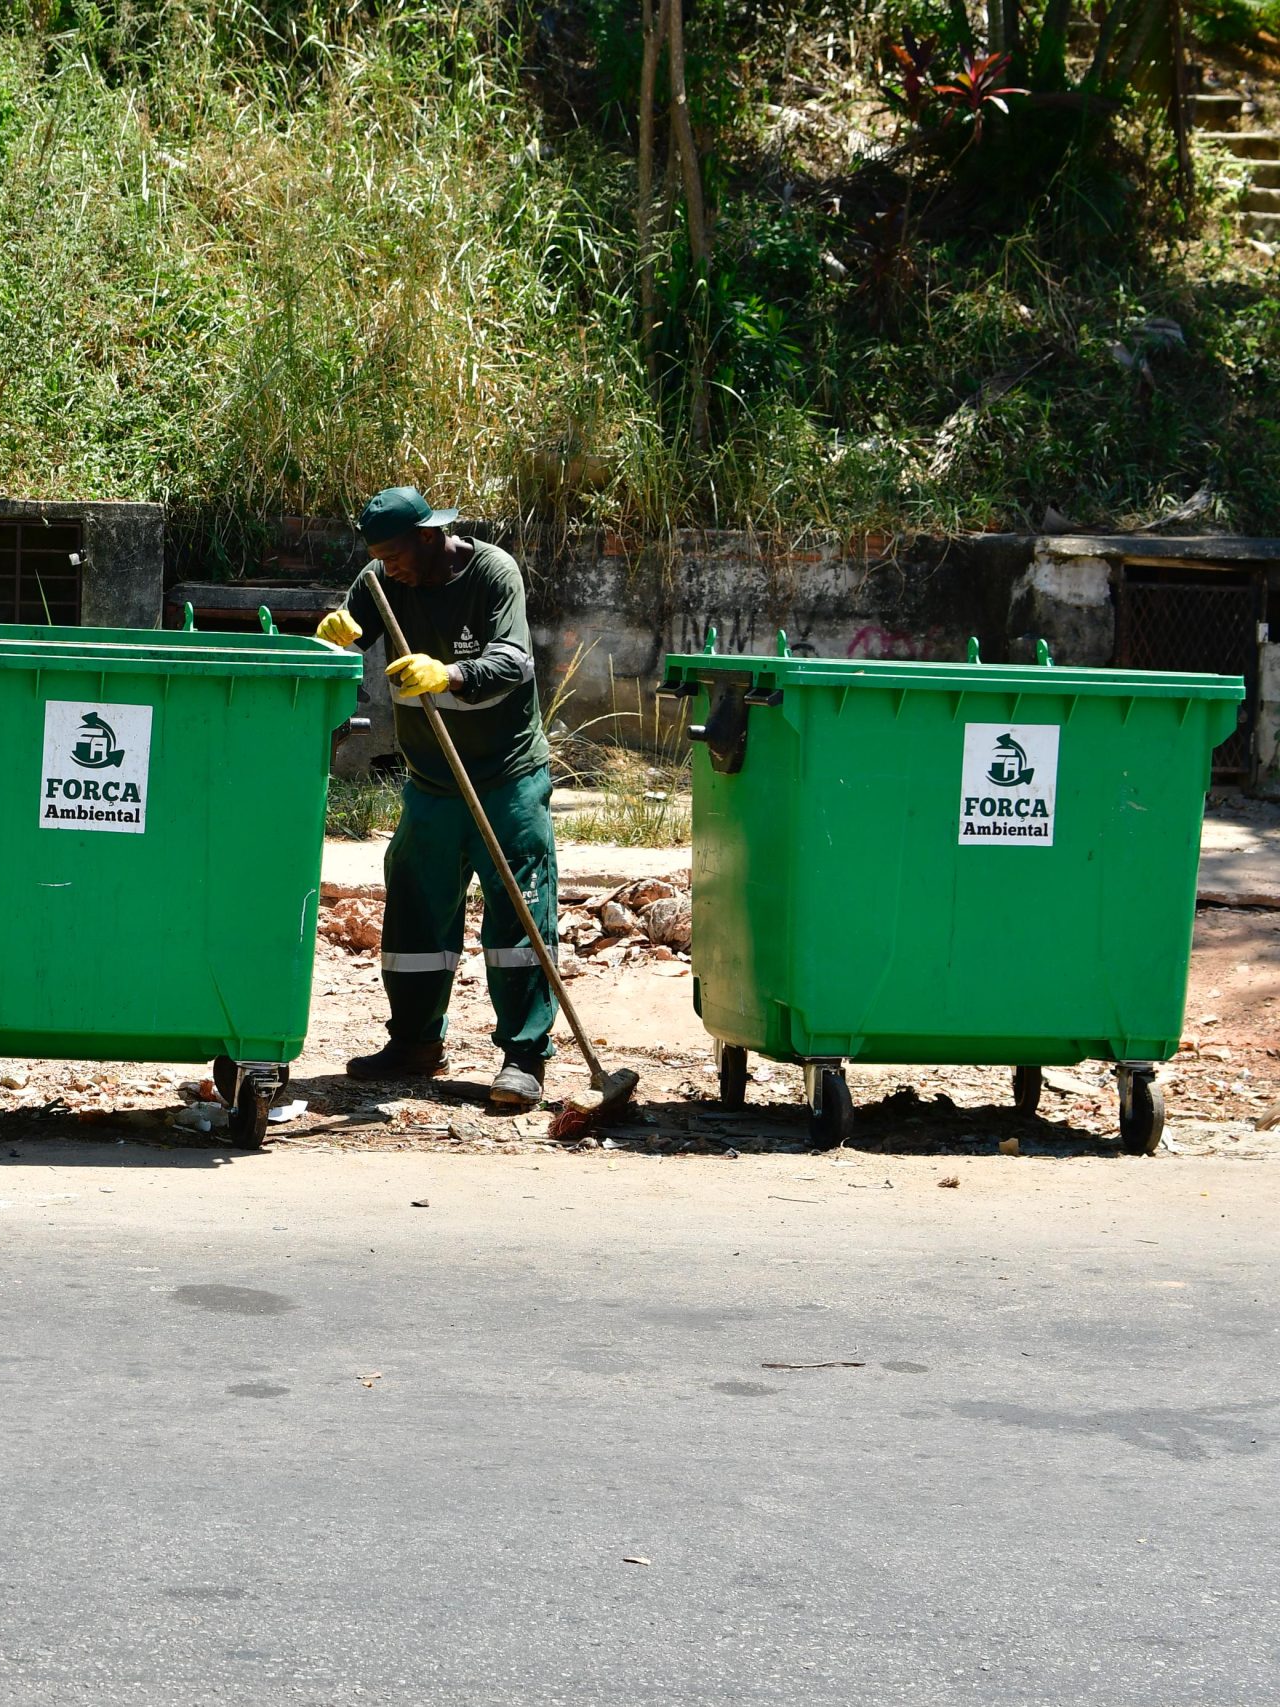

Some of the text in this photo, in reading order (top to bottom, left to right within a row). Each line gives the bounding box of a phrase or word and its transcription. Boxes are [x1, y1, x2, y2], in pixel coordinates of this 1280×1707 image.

[45, 778, 142, 806] FORÇA
[44, 804, 141, 824] Ambiental
[964, 797, 1050, 822] FORÇA
[963, 821, 1049, 837] Ambiental
